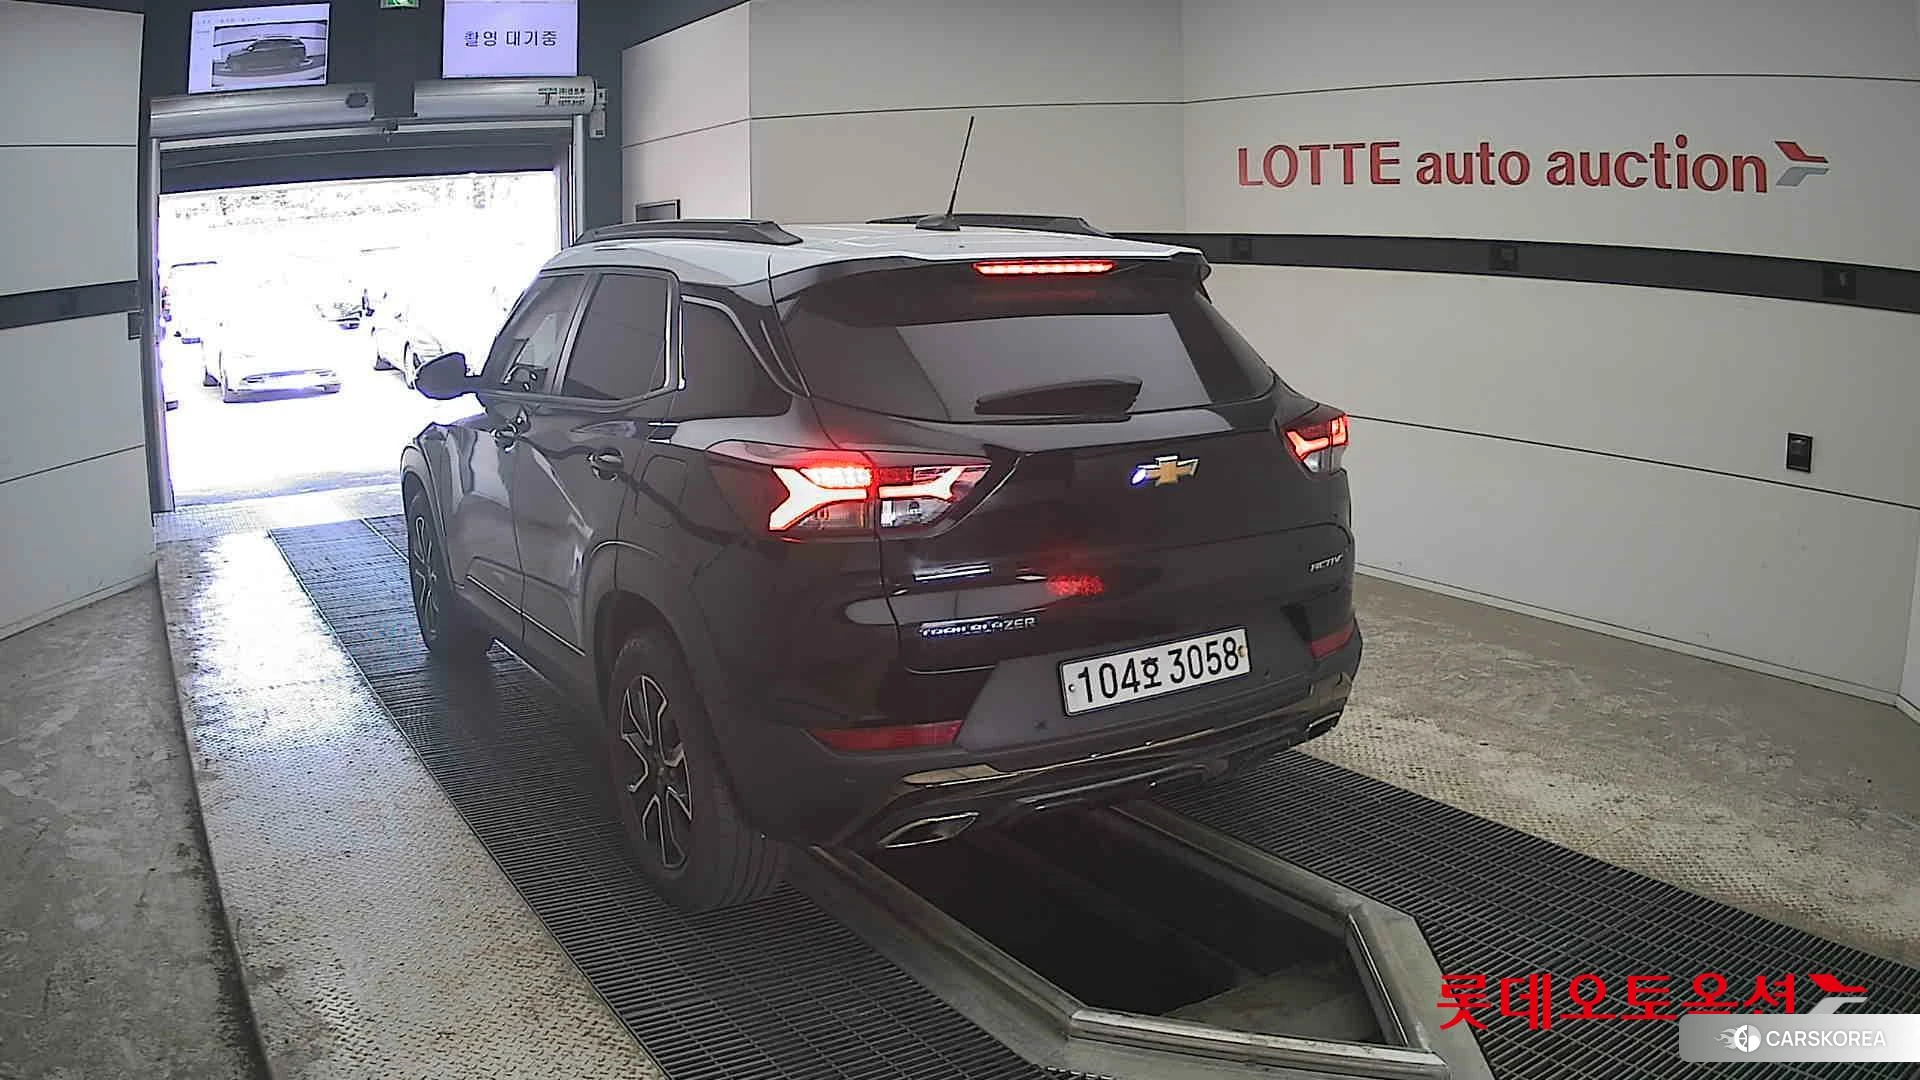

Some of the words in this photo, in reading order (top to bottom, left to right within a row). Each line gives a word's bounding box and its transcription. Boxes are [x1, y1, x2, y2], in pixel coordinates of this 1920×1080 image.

[505, 30, 558, 47] 대기중
[1238, 141, 1400, 187] LOTTE
[1416, 142, 1530, 185] auto
[1546, 134, 1767, 193] auction
[1168, 636, 1239, 684] 3058
